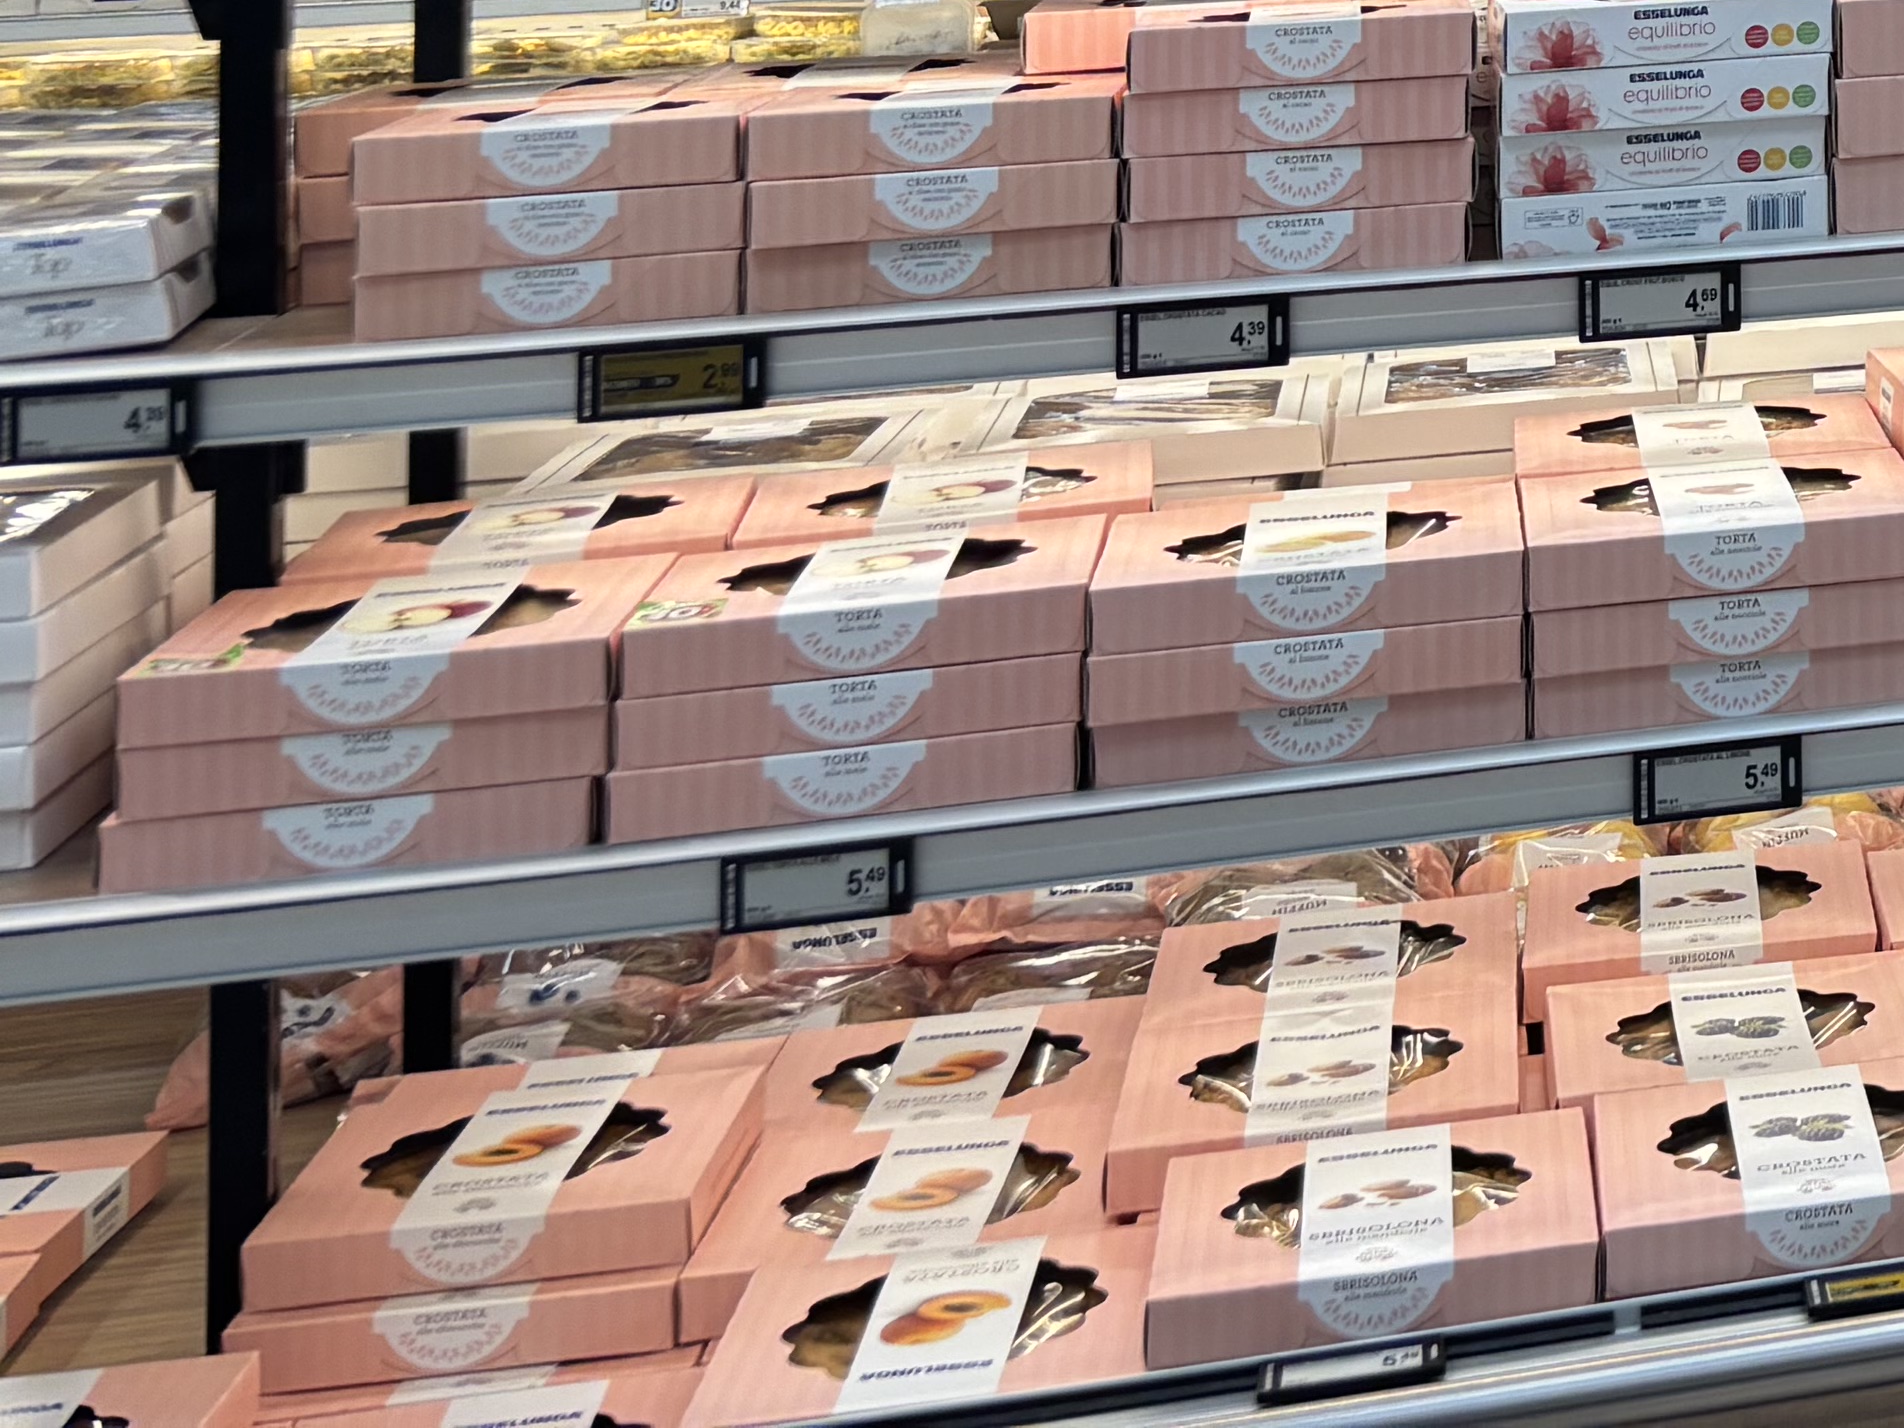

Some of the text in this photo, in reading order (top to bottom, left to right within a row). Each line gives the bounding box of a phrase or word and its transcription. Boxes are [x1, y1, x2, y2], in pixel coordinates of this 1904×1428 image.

[1634, 6, 1708, 20] ESSELUNGA
[1275, 24, 1332, 37] CROSTATA
[1628, 21, 1716, 41] equilibrio
[1629, 68, 1705, 83] ESSELUNGA
[1268, 89, 1326, 101] CROSTATA
[1623, 83, 1711, 105] equilibrio
[899, 106, 964, 123] CROSTATA
[514, 129, 578, 146] CROSTATA
[1626, 130, 1701, 144] ESSELUNGA
[1275, 153, 1333, 165] CROSTATA
[1620, 144, 1709, 166] equilibrio
[906, 173, 972, 191] CROSTATA
[520, 197, 588, 214] CROSTATA
[1266, 216, 1324, 229] CROSTATA
[899, 238, 964, 255] CROSTATA
[514, 266, 581, 283] CROSTATA
[1684, 288, 1718, 312] 4,69
[1230, 321, 1266, 347] 4,39
[1715, 532, 1757, 546] TORTA
[1276, 569, 1346, 586] CROSTATA
[1718, 597, 1761, 611] TORTA
[835, 608, 883, 622] TORTA
[1274, 638, 1344, 655] CROSTATA
[1719, 660, 1761, 674] TORTA
[829, 679, 877, 694] TORTA
[1278, 702, 1348, 718] CROSTATA
[821, 751, 871, 767] TORTA
[1745, 762, 1778, 789] 5,49
[846, 865, 887, 897] 5,49
[1668, 949, 1736, 964] SBRISOLONA
[1785, 1202, 1853, 1223] CROSTATA
[1333, 1269, 1419, 1291] SBRISOLONA
